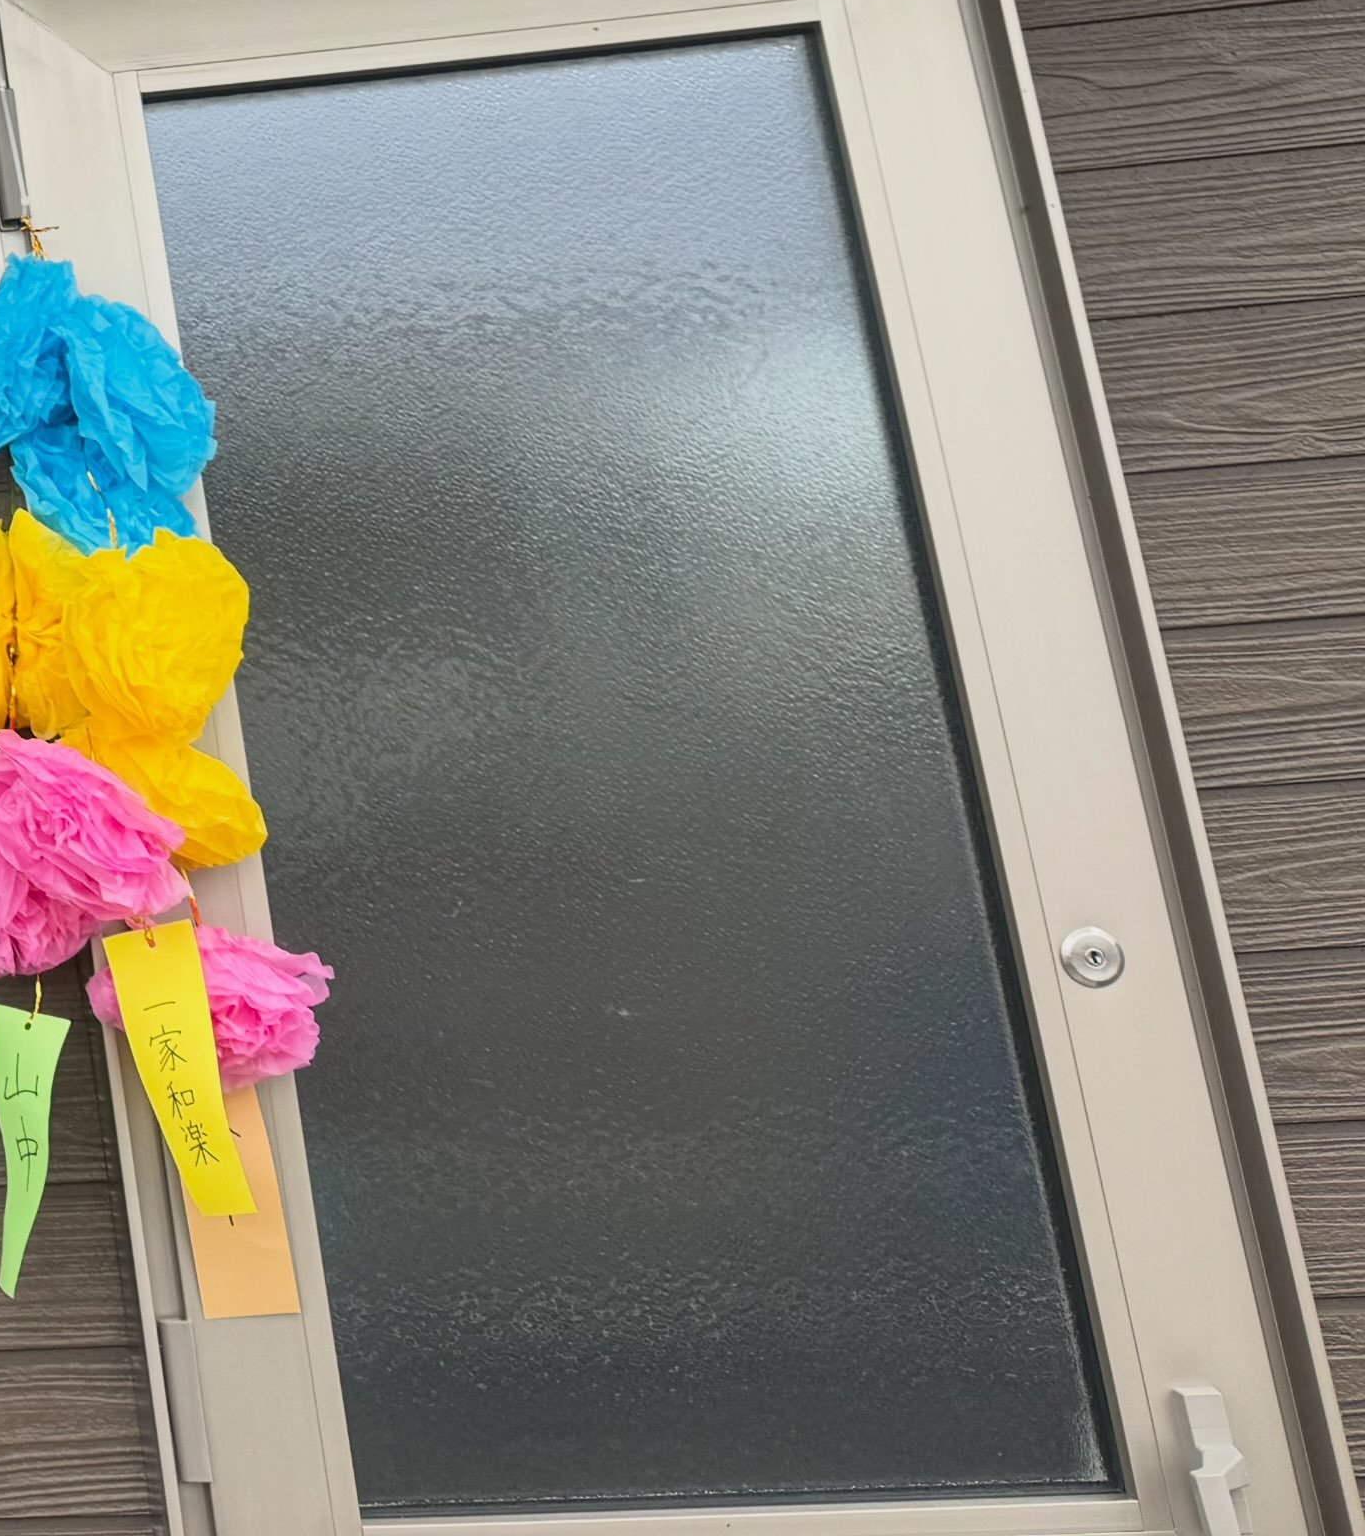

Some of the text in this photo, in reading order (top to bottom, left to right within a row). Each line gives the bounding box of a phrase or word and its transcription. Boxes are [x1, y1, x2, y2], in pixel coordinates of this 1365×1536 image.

[3, 1052, 39, 1192] 山中
[142, 1000, 220, 1168] 一家和楽
